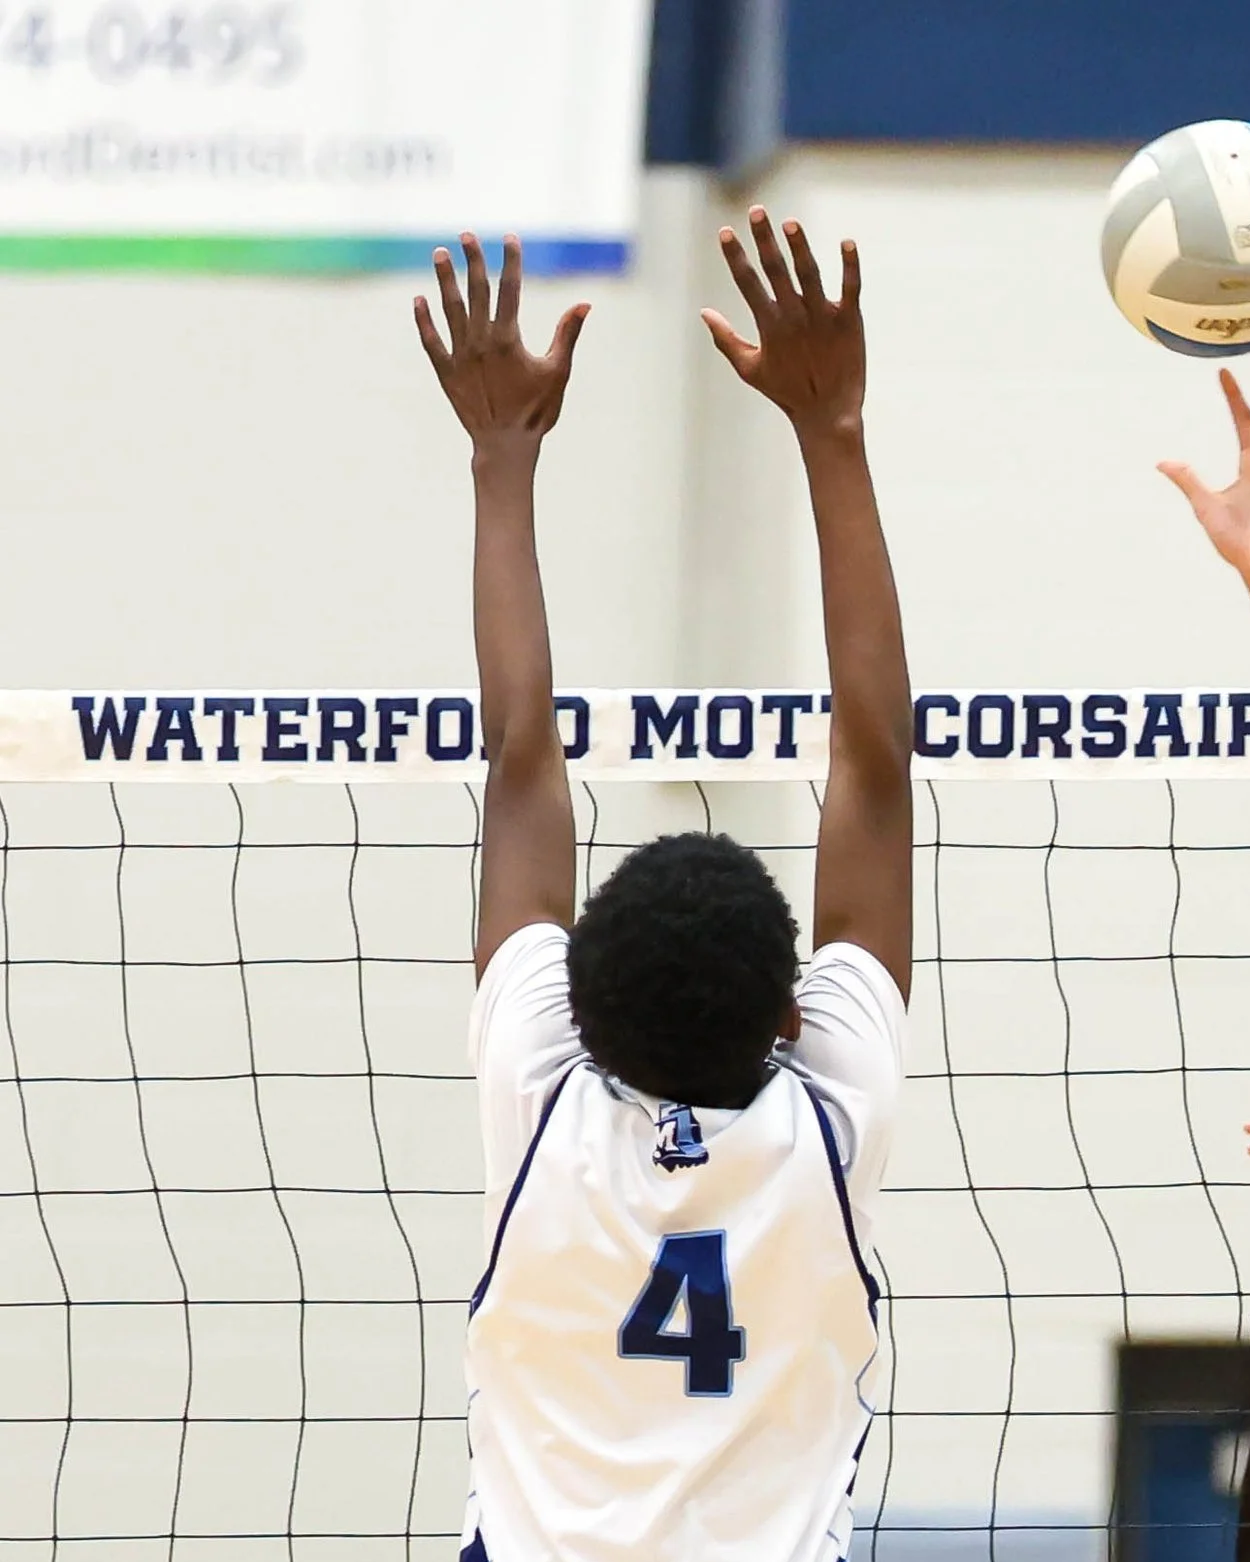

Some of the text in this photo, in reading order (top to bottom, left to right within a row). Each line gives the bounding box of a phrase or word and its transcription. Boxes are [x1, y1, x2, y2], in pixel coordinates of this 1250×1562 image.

[72, 696, 590, 763] WATERFOD
[630, 694, 832, 759] MOT
[617, 1229, 747, 1397] 4
